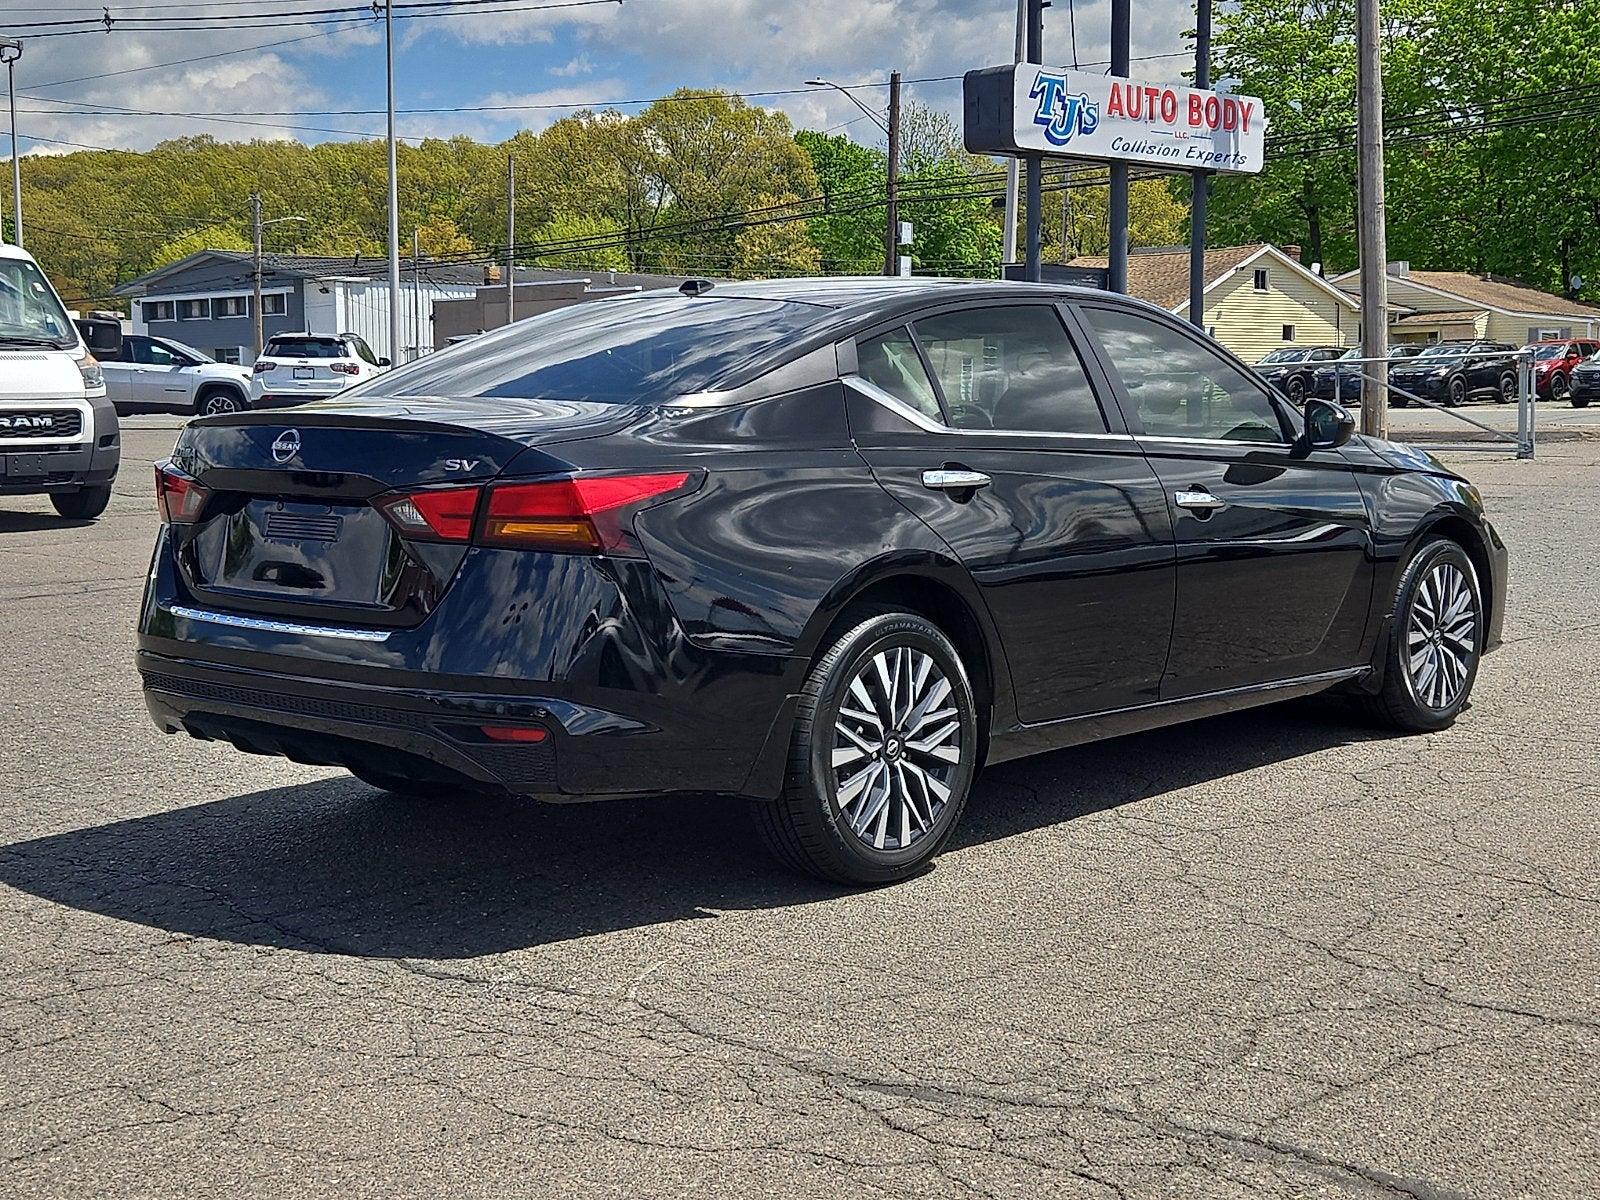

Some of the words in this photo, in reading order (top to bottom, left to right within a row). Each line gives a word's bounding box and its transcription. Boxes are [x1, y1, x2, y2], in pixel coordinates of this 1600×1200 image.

[1107, 82, 1177, 123] AUTO
[1188, 93, 1254, 132] BODY
[1174, 131, 1189, 139] LLC.
[1111, 136, 1180, 158] Collision
[1185, 146, 1248, 165] Experts
[0, 417, 53, 428] RAM
[445, 459, 480, 471] SV
